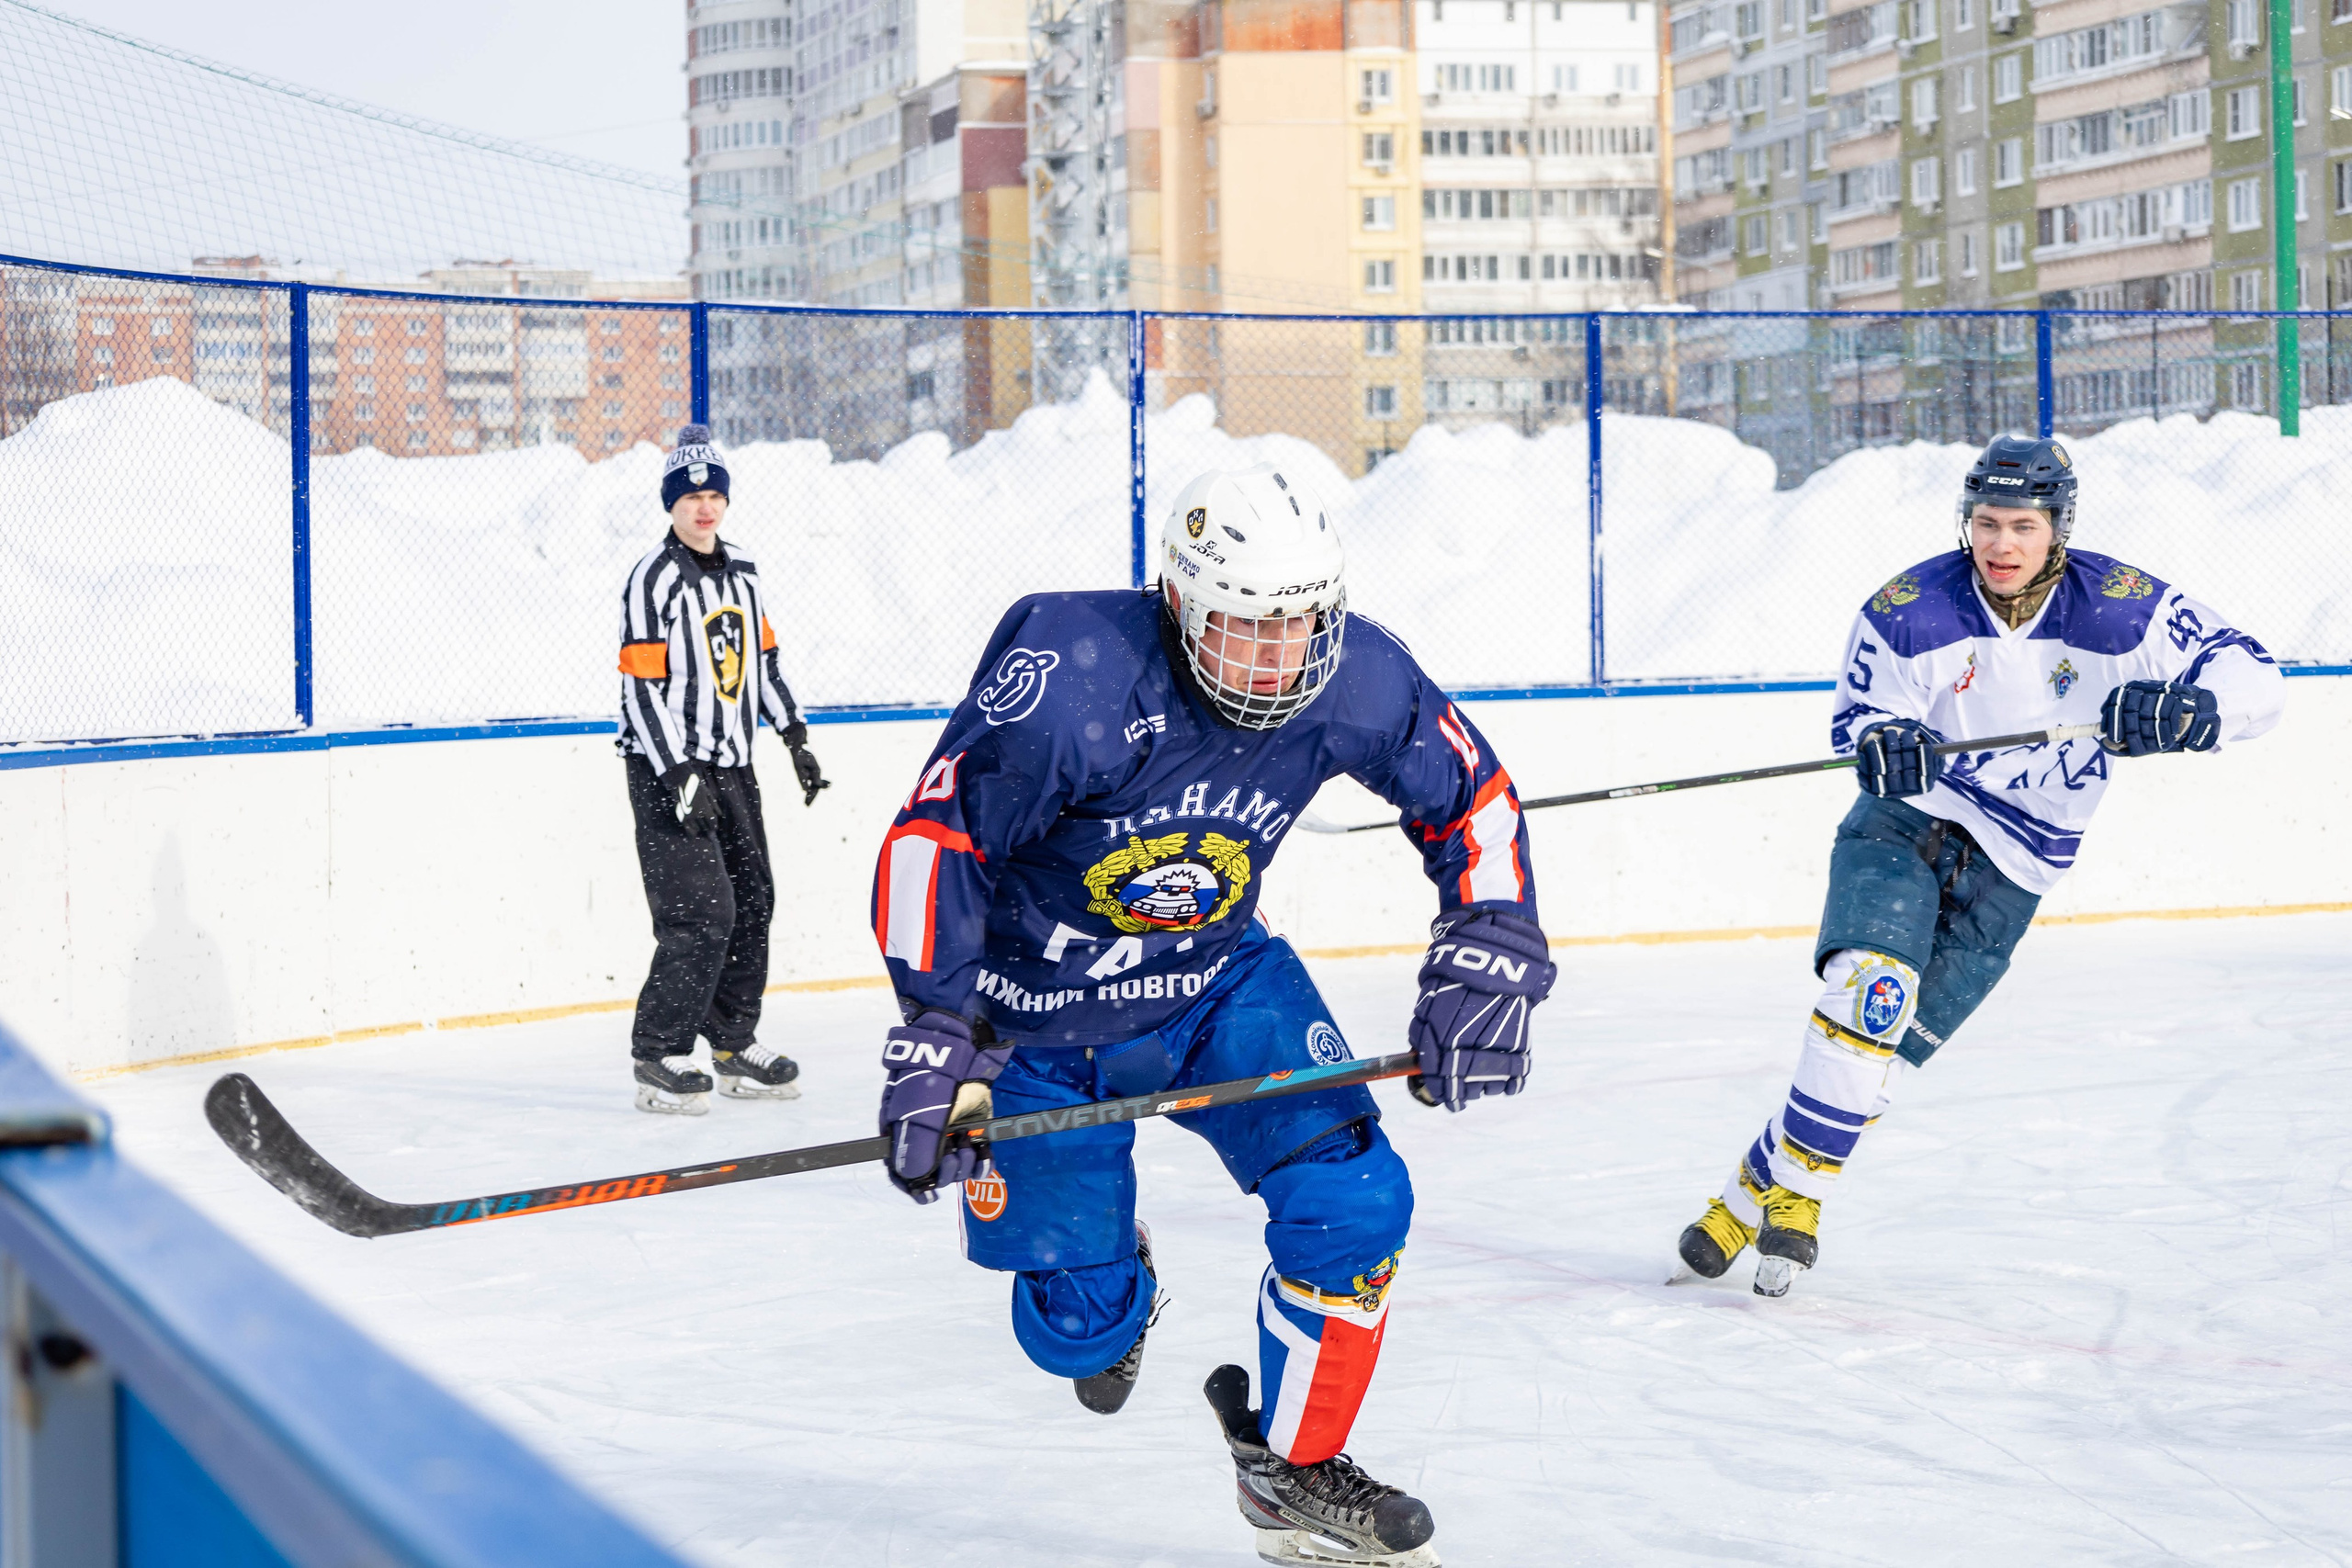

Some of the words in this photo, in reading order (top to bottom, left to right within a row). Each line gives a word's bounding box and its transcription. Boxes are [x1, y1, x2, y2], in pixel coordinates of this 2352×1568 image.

[667, 446, 722, 467] ОККЕ
[1986, 476, 2025, 486] CCM
[1177, 552, 1201, 573] ДИНАМО
[1189, 543, 1226, 565] JOFA
[1177, 561, 1196, 580] ГАИ
[1268, 580, 1328, 597] JOFA
[1043, 921, 1193, 981] ГА
[976, 968, 1084, 1012] ИЖНИ
[1098, 955, 1228, 1000] НОВГОР
[1911, 1019, 1943, 1048] AUER
[885, 1039, 952, 1067] ON
